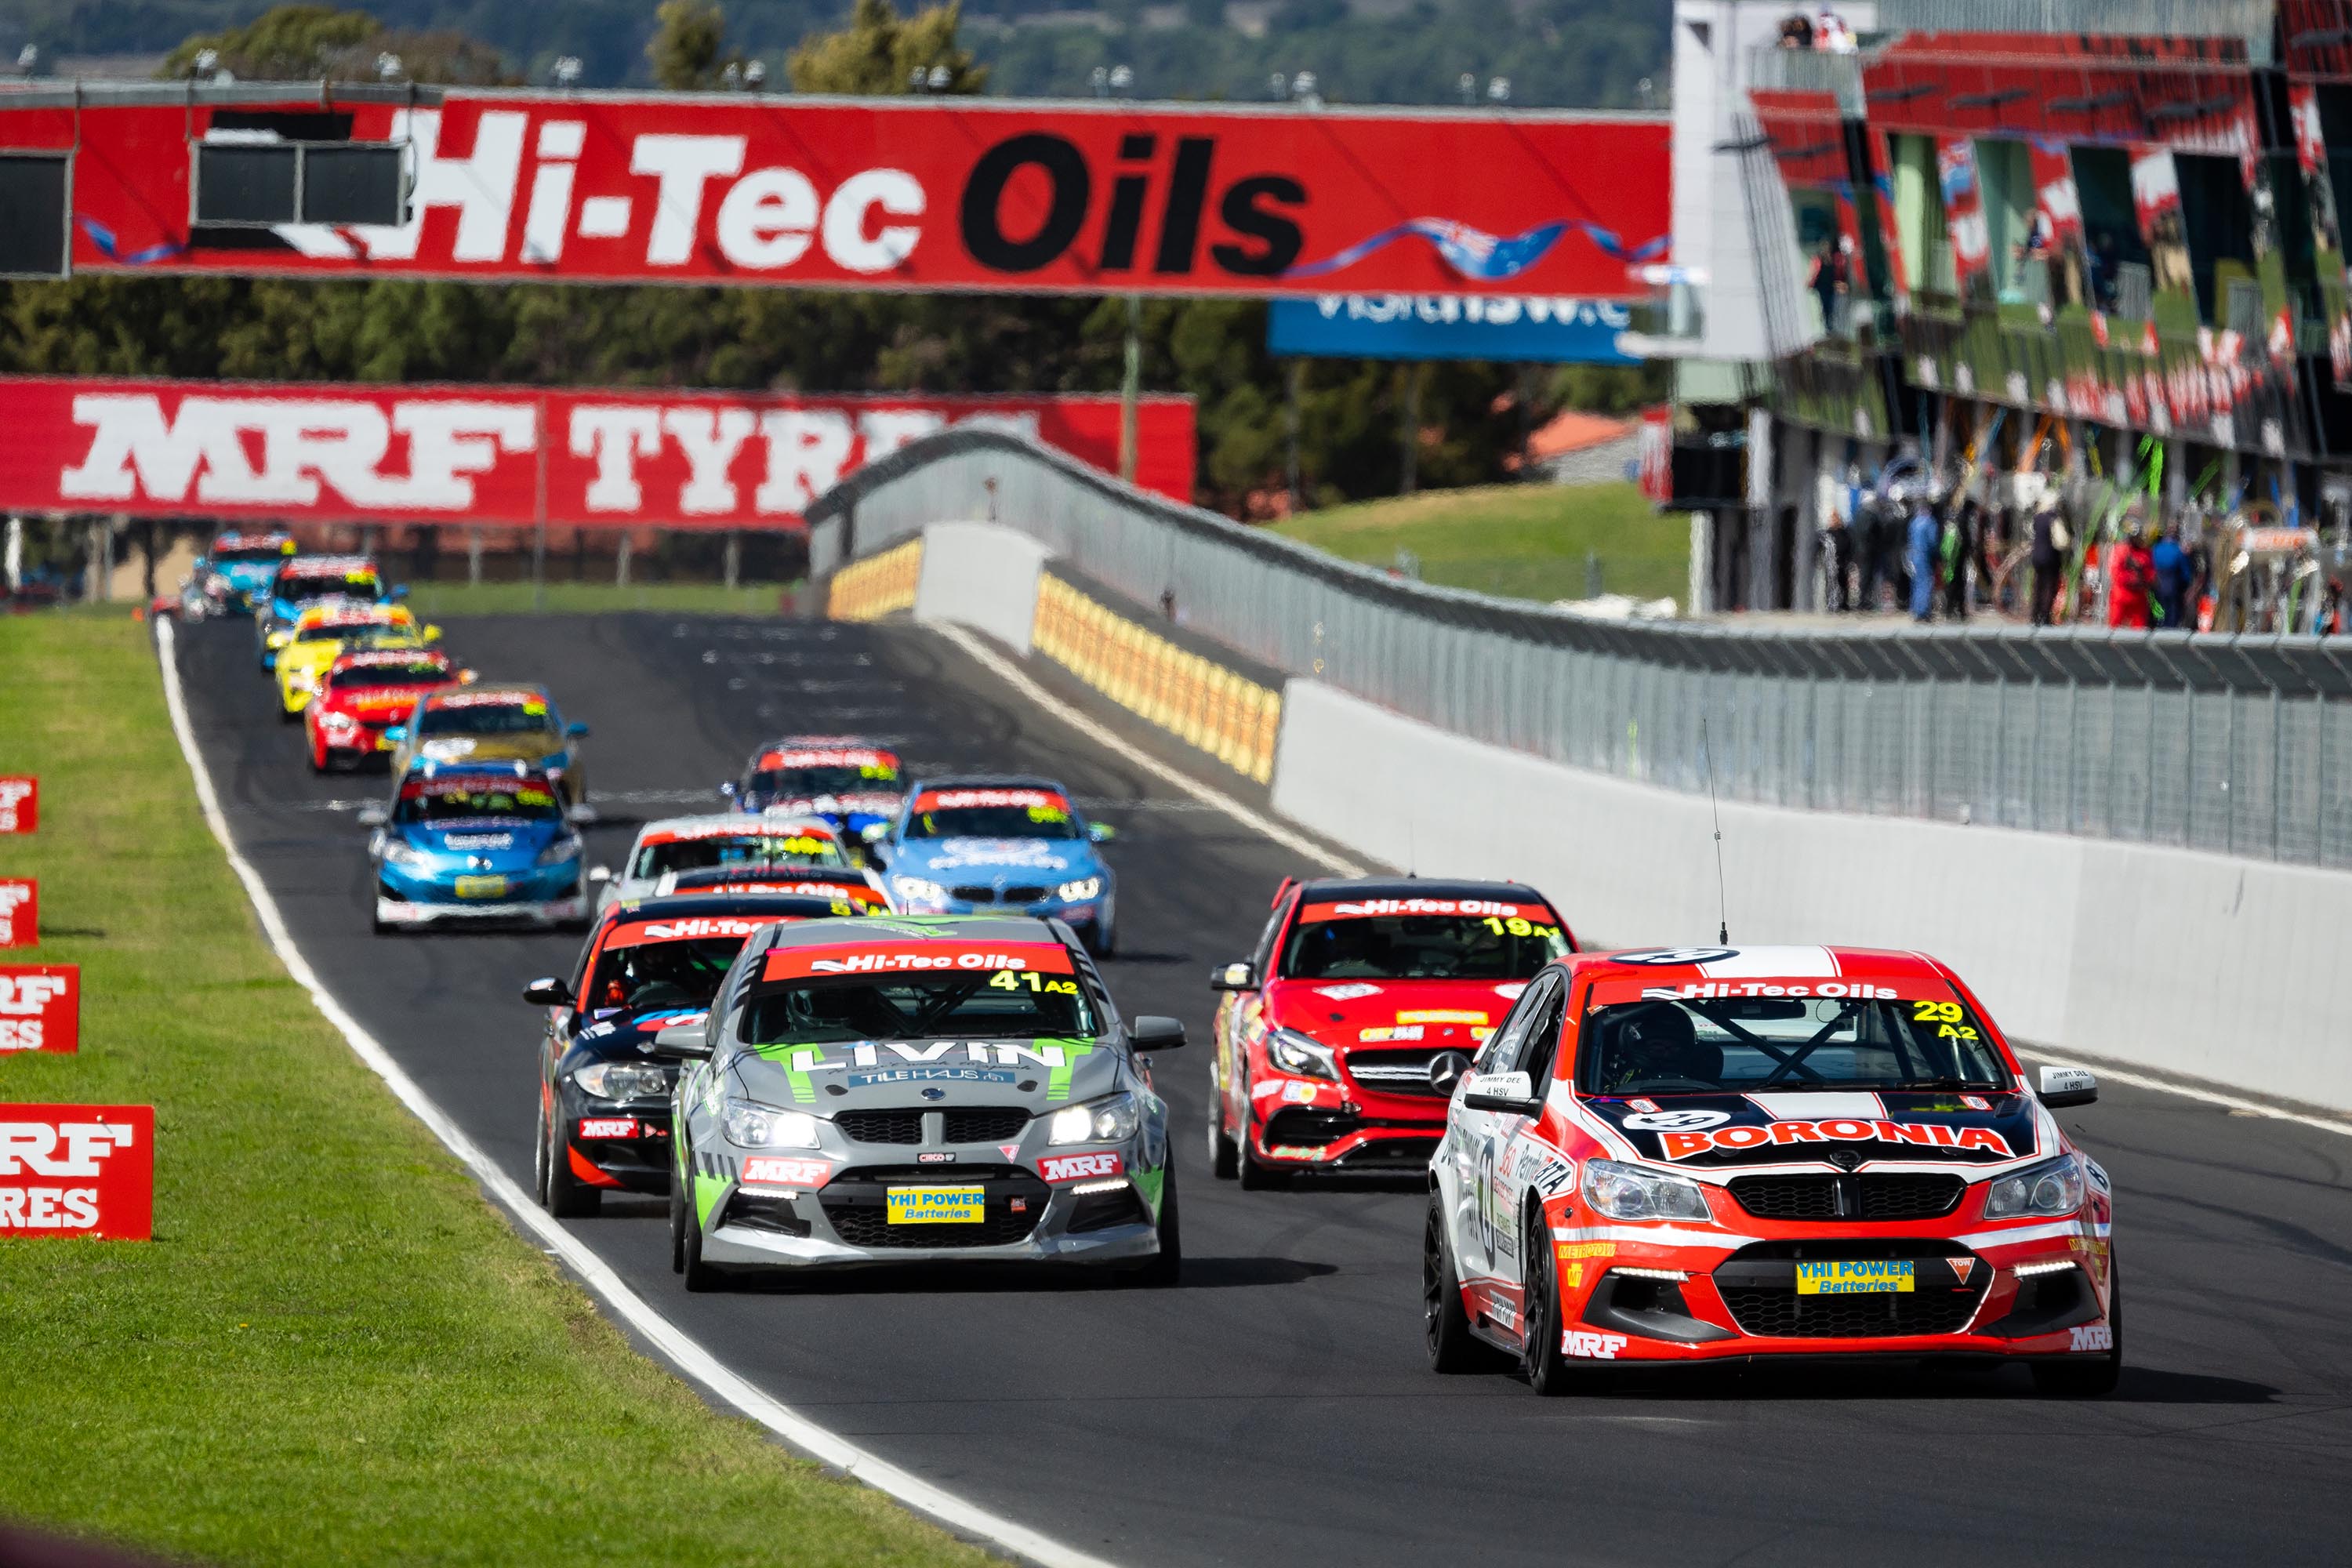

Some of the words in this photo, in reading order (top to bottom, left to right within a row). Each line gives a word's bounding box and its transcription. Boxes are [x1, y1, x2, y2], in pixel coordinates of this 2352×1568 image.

[367, 109, 927, 273] Hi-Tec
[959, 132, 1308, 275] Oils
[60, 394, 536, 510] MRF
[568, 404, 1040, 514] TYR
[1363, 899, 1456, 915] Hi-Tec
[1458, 899, 1518, 916] Oils
[1483, 916, 1533, 937] 19
[844, 954, 952, 971] Hi-Tec
[957, 953, 1026, 970] Oils
[989, 970, 1042, 993] 41
[1044, 981, 1079, 995] A2
[1682, 982, 1810, 999] Hi-Tec
[1816, 982, 1898, 1000] Oils
[1914, 1000, 1963, 1023] 29
[1939, 1024, 1979, 1040] A2
[2052, 1071, 2074, 1080] JIMMY
[1493, 1087, 1509, 1097] HSV
[582, 1120, 635, 1138] MRF
[1657, 1119, 2017, 1161] BORONIA
[744, 1159, 829, 1185] MRF
[1044, 1152, 1120, 1180] MRF
[1534, 1160, 1572, 1196] BTA
[887, 1193, 916, 1207] YHI
[922, 1192, 985, 1207] POWER
[905, 1207, 971, 1220] Batteries
[1559, 1243, 1616, 1258] METROTOW
[1798, 1261, 1833, 1278] YHI
[1838, 1260, 1914, 1278] POWER
[1819, 1279, 1898, 1294] Batteries
[1561, 1330, 1627, 1359] MRF
